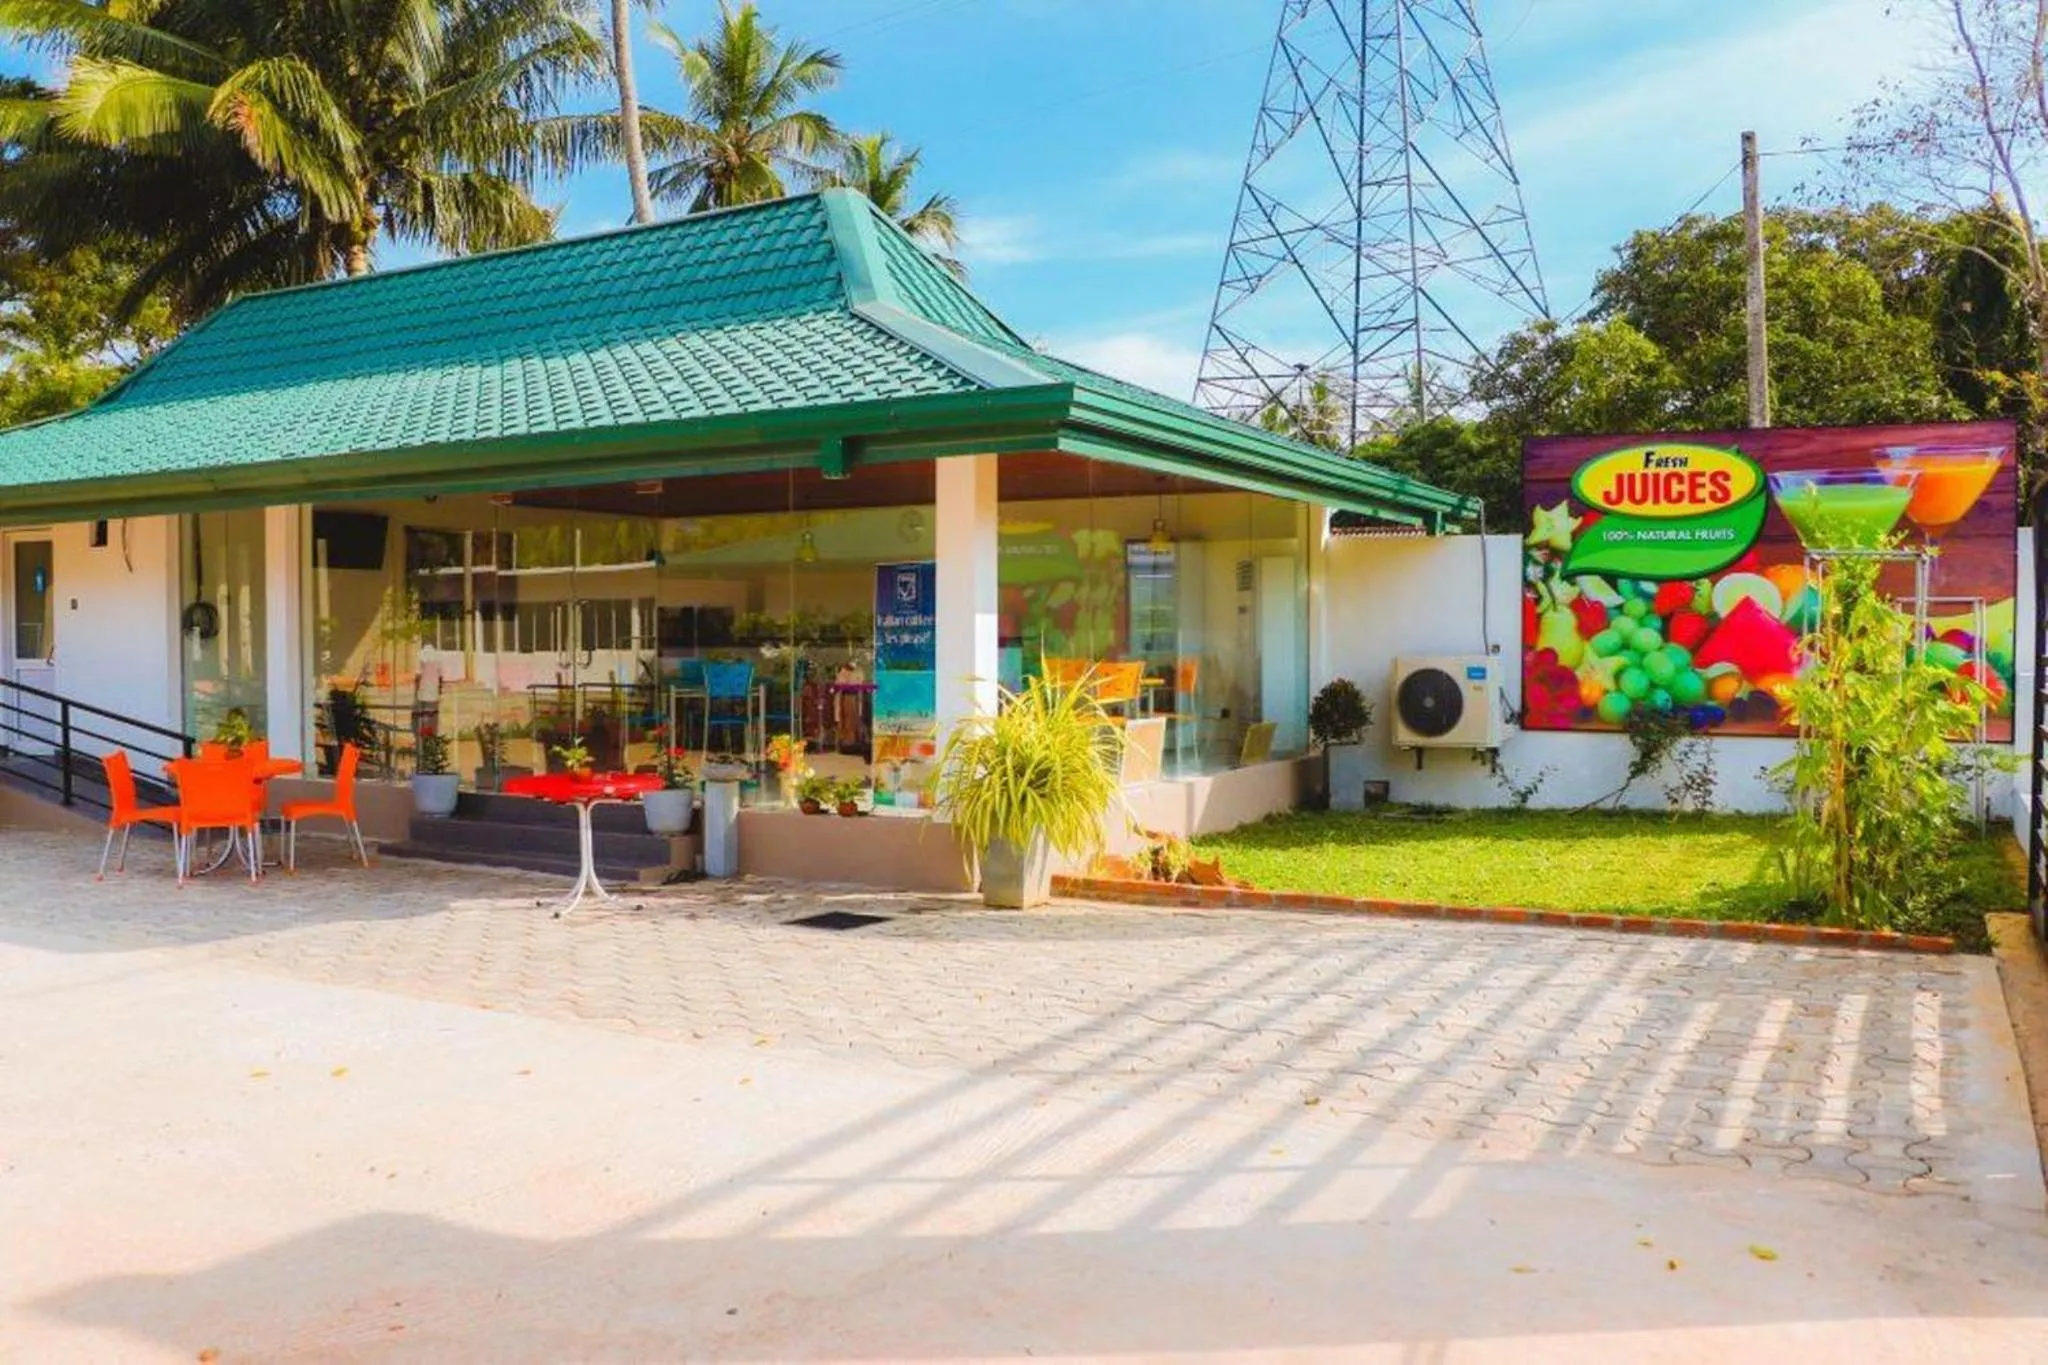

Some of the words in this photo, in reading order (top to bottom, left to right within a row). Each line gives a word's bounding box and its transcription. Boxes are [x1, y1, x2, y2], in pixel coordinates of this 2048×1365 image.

[1602, 470, 1732, 506] JUICES
[1602, 531, 1633, 541] 100%
[1636, 530, 1692, 541] NATURAL
[1695, 528, 1735, 541] FRUITS
